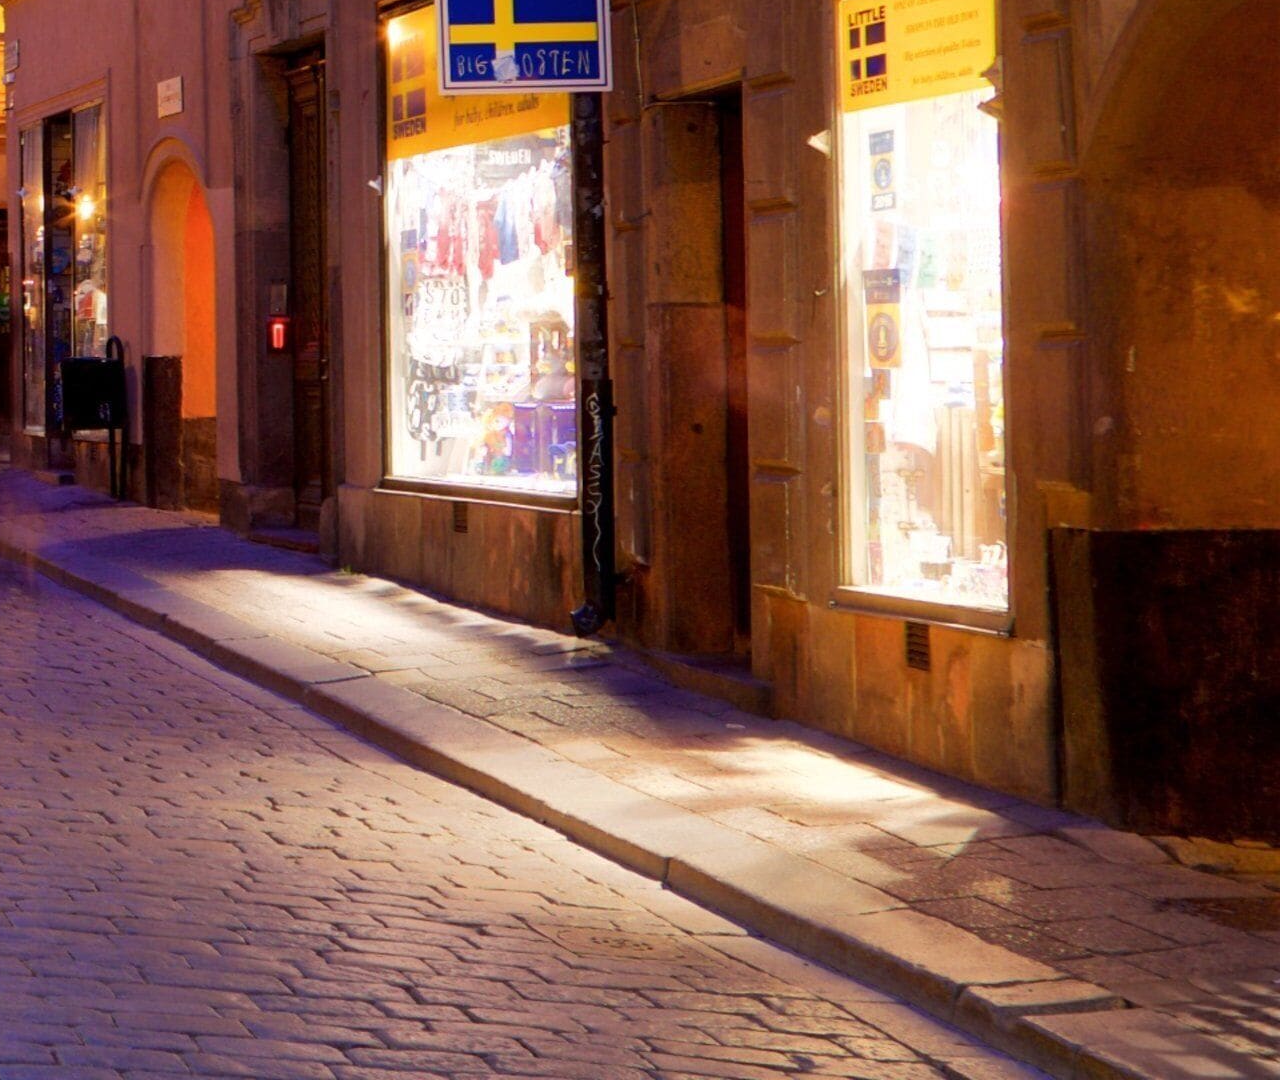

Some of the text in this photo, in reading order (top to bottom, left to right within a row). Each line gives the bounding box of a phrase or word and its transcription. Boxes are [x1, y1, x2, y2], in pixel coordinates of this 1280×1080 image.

[848, 5, 886, 27] LITTLE
[456, 54, 489, 77] BIG
[850, 77, 888, 98] SWEDEN
[393, 117, 426, 140] SWEDEN
